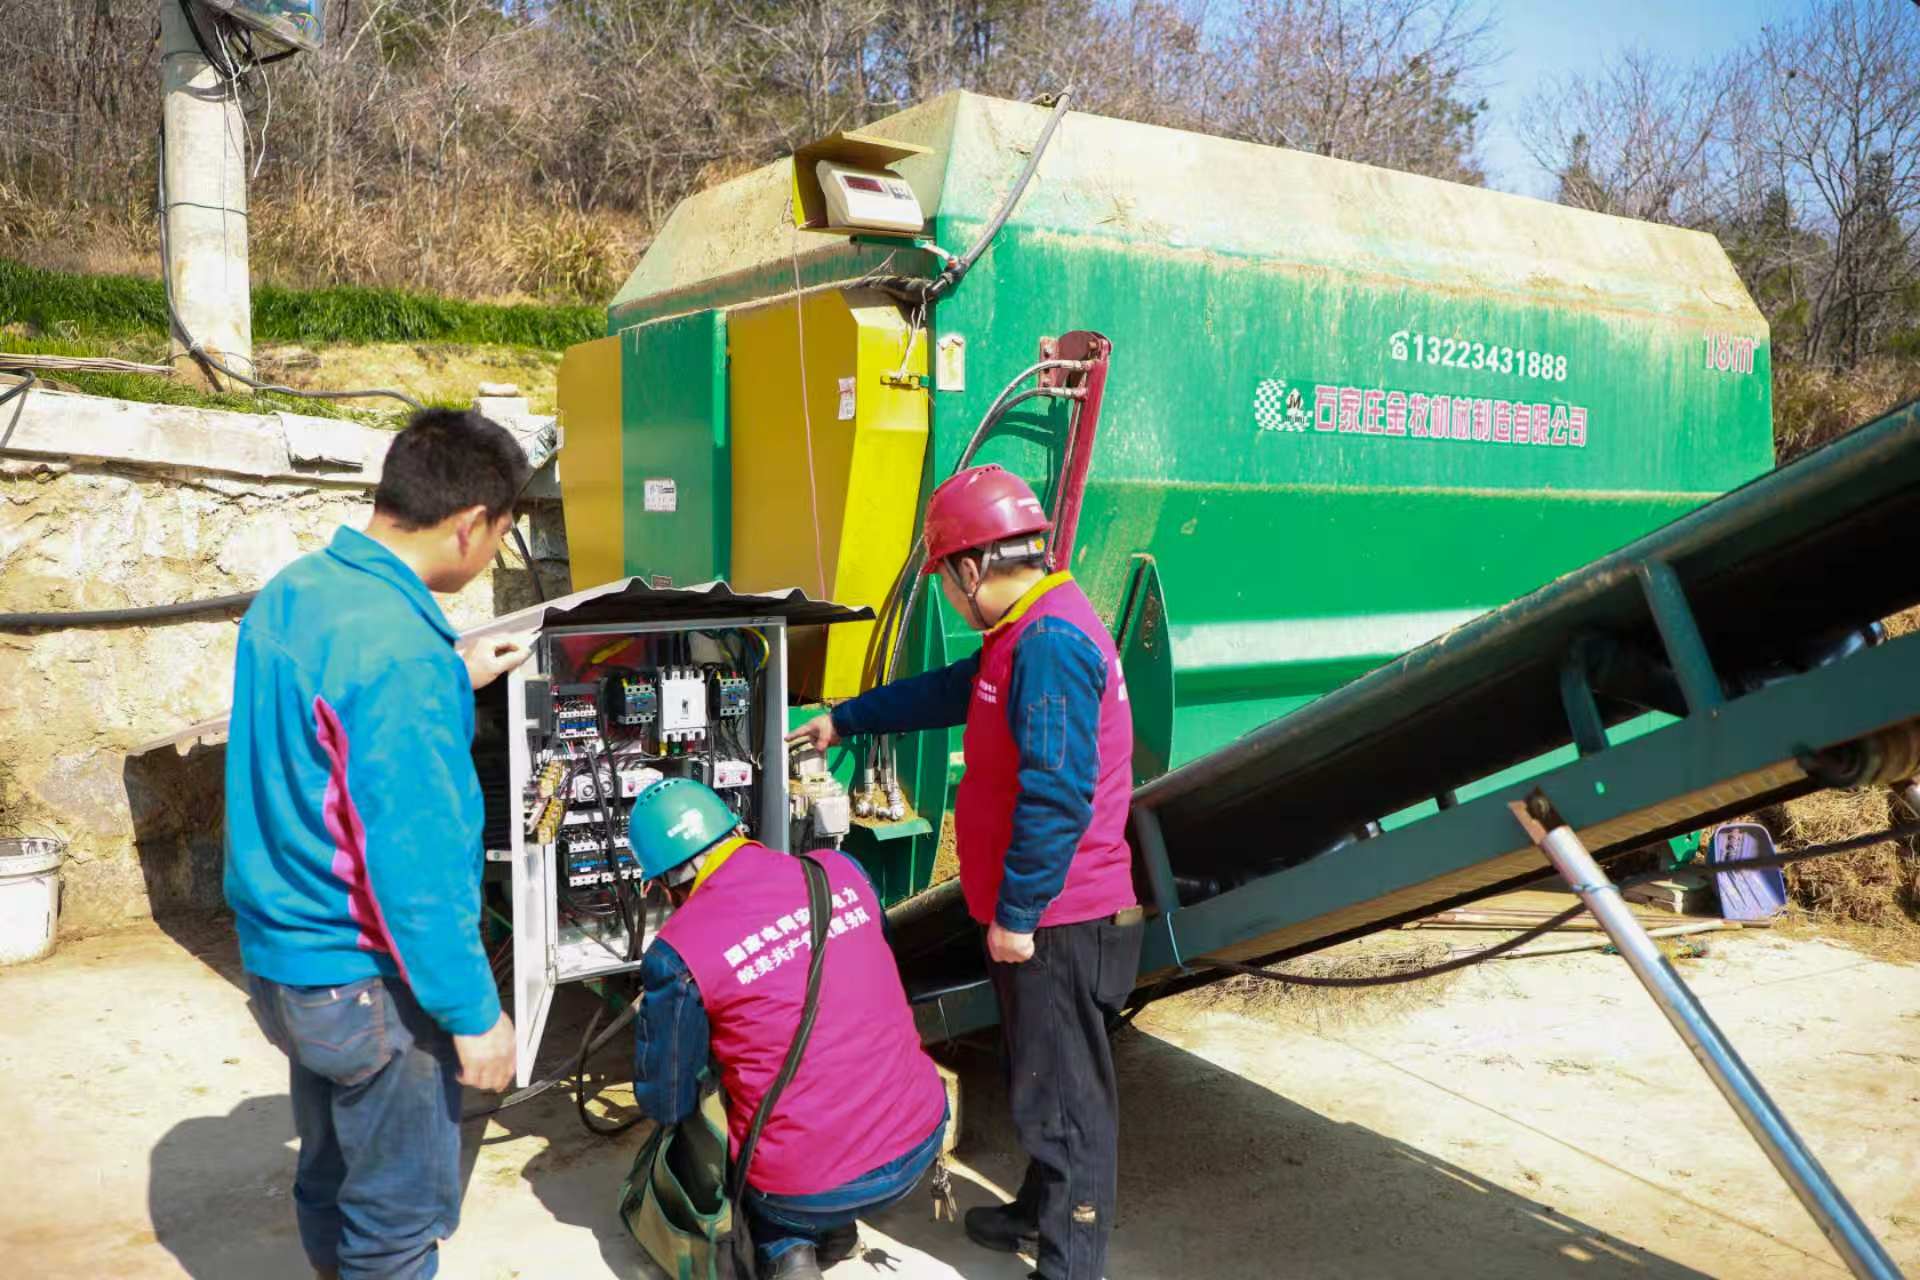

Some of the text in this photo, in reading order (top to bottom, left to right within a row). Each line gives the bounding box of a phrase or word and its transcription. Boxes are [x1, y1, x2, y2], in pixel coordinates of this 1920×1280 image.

[1413, 333, 1567, 381] 13223431888
[1314, 384, 1587, 447] 石家庄金牧机械制造有限公司
